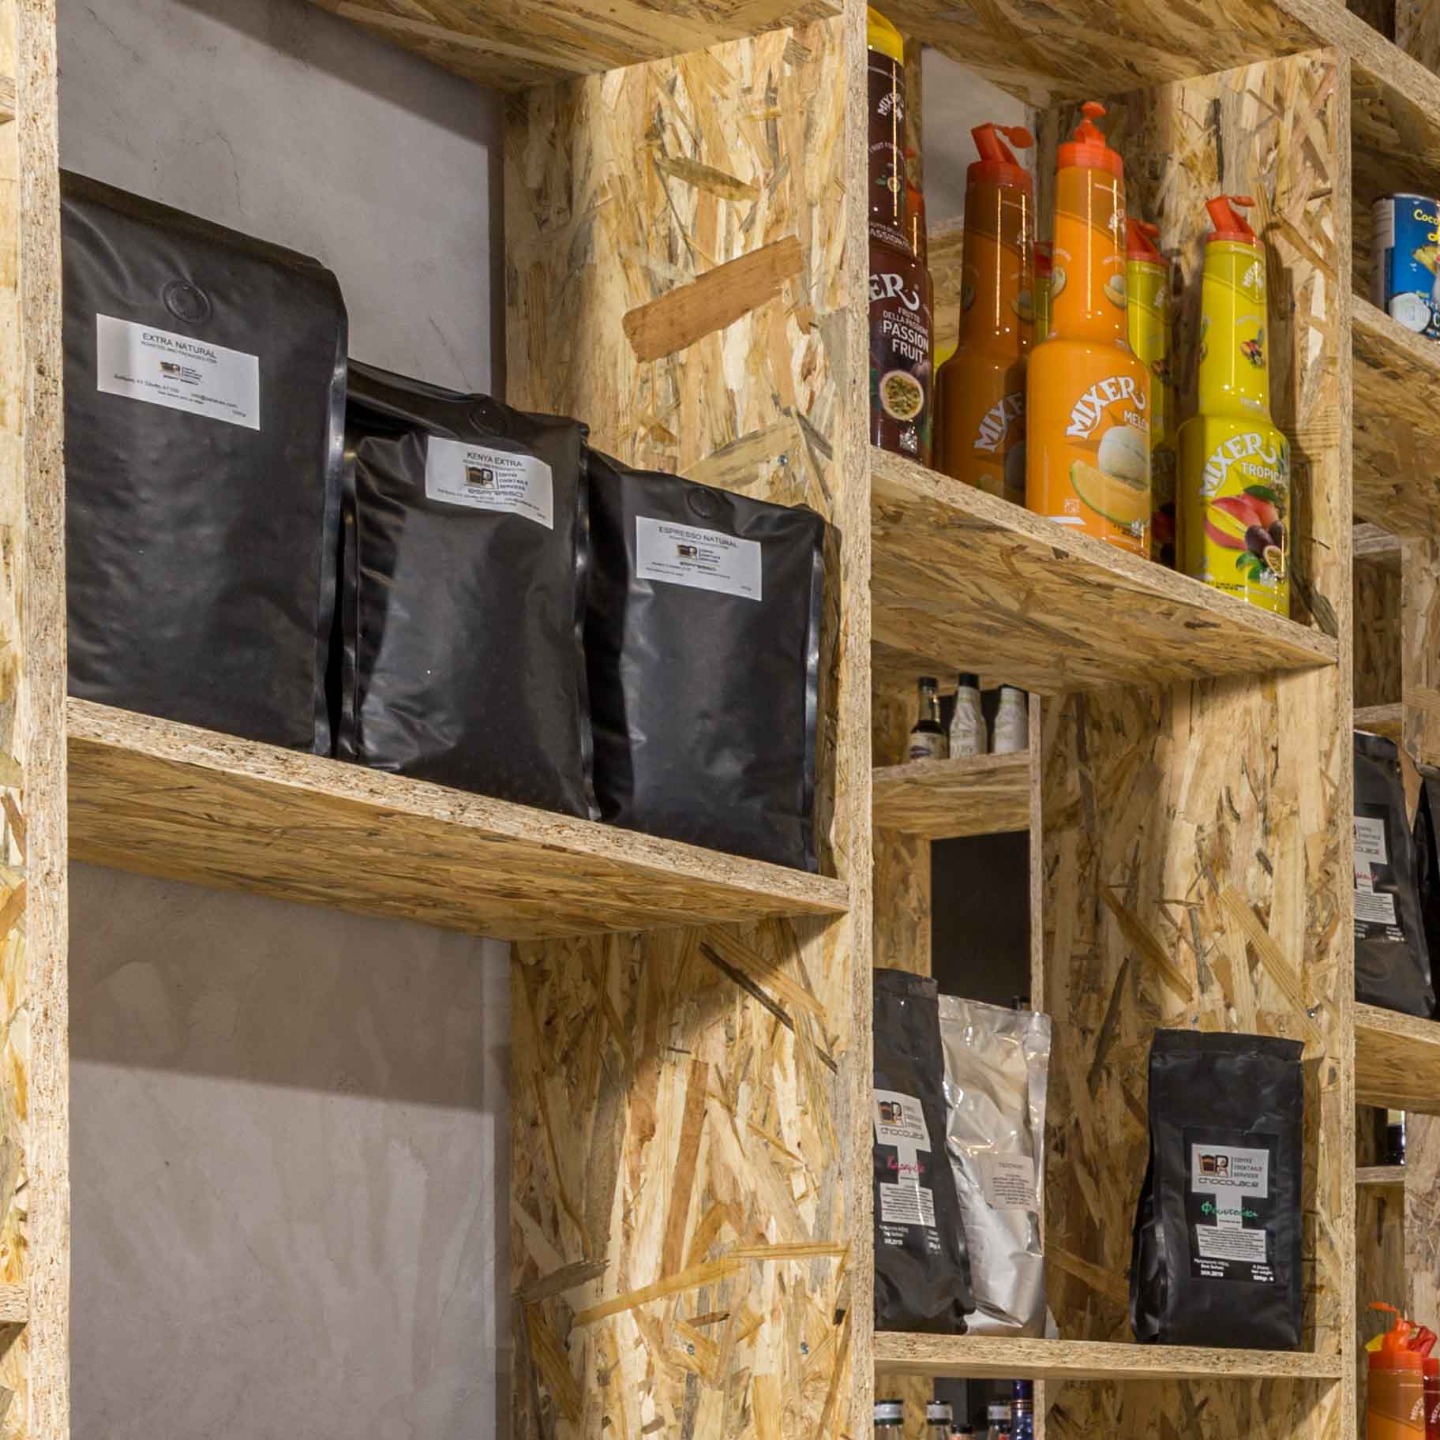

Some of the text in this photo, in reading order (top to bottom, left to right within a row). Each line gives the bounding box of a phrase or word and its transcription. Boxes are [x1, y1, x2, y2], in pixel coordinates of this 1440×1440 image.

[1413, 209, 1440, 226] Coco
[142, 332, 173, 347] EXTRA
[175, 342, 217, 359] NATURAL
[883, 322, 929, 352] PASSION
[892, 339, 924, 364] FRUIT
[1065, 375, 1147, 438] MIXER
[467, 451, 493, 463] KENYA
[494, 457, 523, 468] EXTRA
[1200, 432, 1277, 497] MIXER
[659, 526, 702, 540] ESPRESSO
[703, 535, 738, 548] NATURAL
